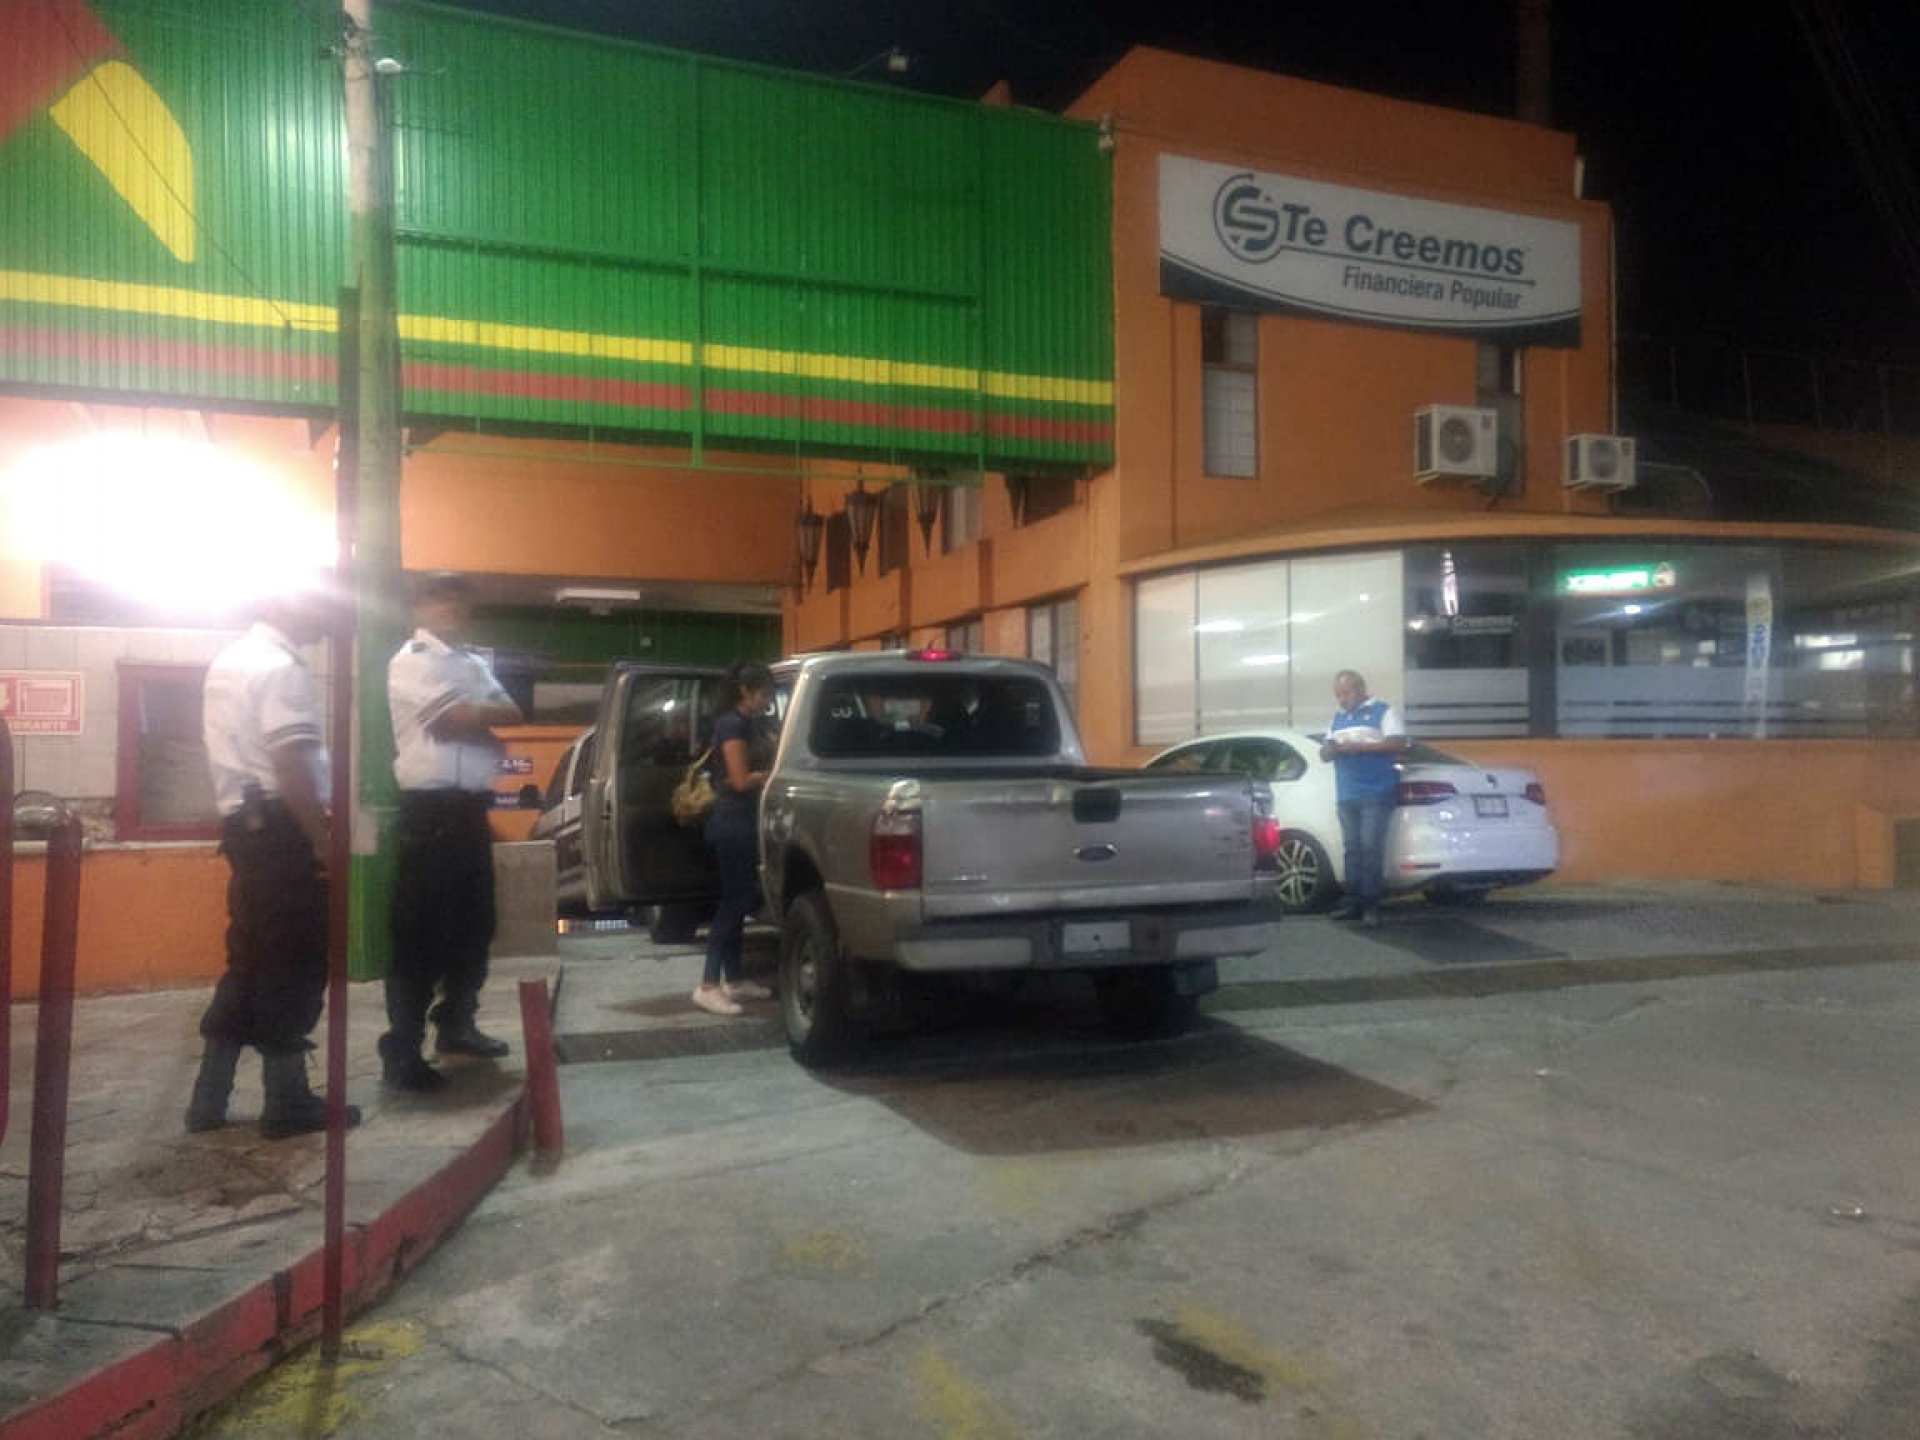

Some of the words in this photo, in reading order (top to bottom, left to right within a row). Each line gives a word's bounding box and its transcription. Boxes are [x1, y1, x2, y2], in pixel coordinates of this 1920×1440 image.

[1282, 203, 1328, 246] Te
[1344, 214, 1524, 275] Creemos
[1343, 265, 1444, 300] Financiera
[1450, 279, 1521, 309] Popular
